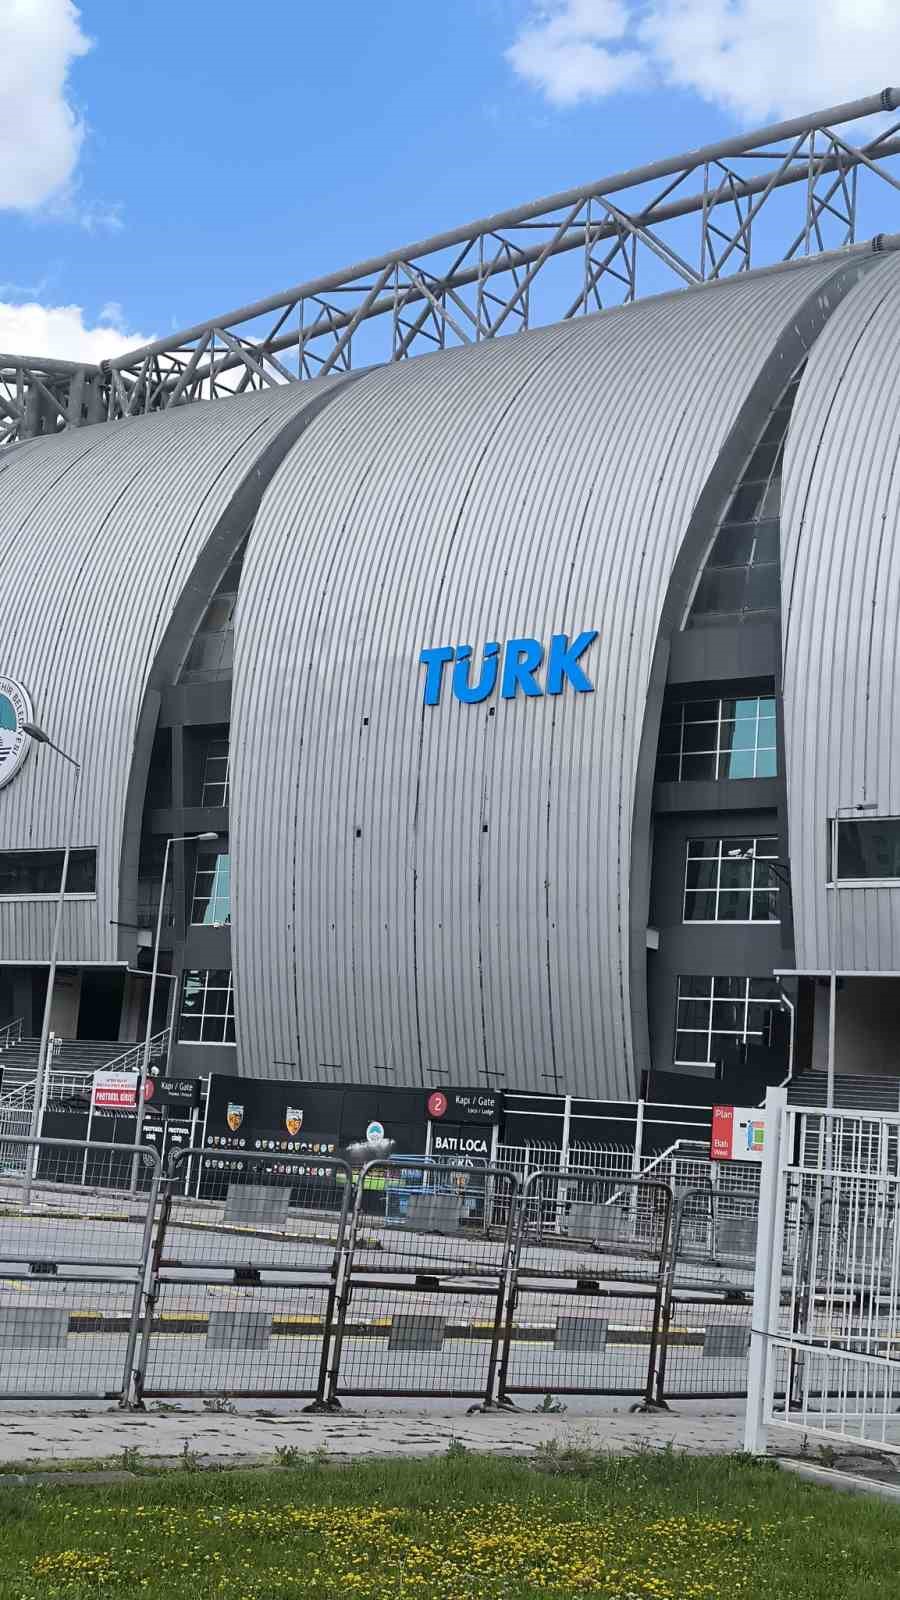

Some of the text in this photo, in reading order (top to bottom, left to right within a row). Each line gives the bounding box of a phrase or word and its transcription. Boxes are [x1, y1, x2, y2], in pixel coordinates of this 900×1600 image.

[419, 629, 599, 705] TÜRK
[179, 1082, 193, 1091] Gate
[434, 1097, 442, 1111] 2
[455, 1095, 471, 1106] Kapı
[478, 1097, 496, 1107] Gate
[715, 1109, 733, 1119] Plan
[435, 1136, 488, 1153] BATI LOCA
